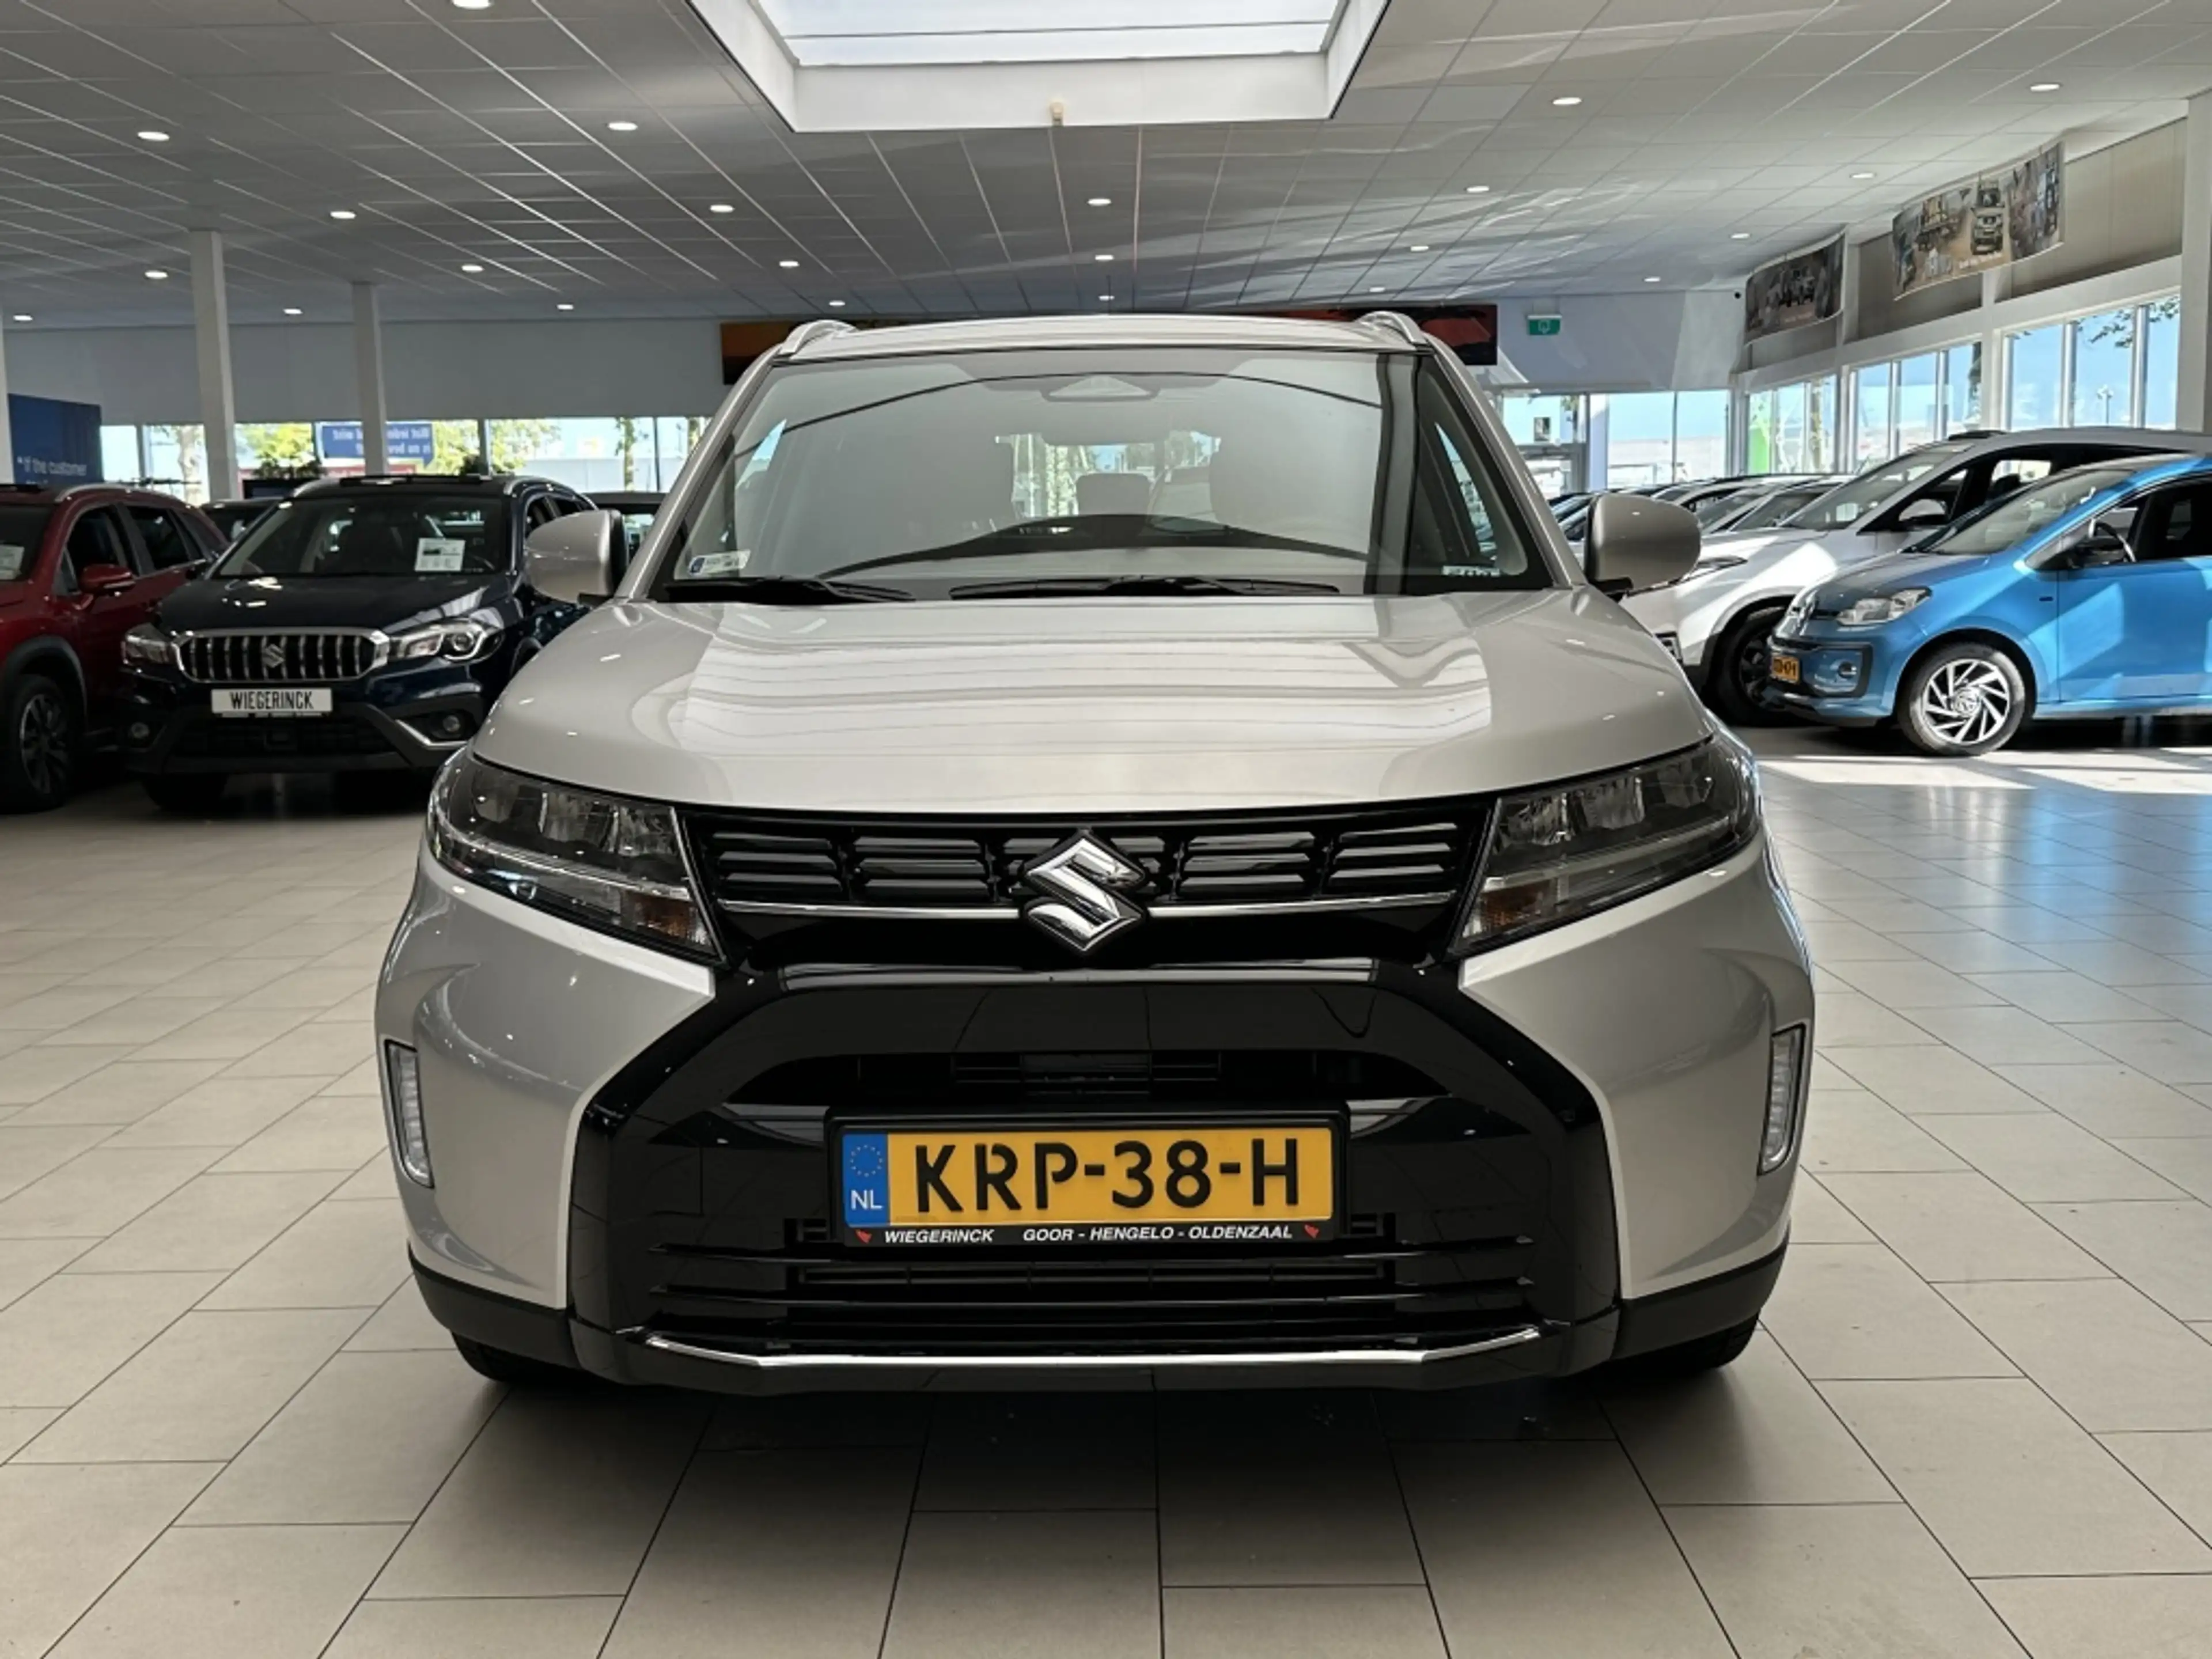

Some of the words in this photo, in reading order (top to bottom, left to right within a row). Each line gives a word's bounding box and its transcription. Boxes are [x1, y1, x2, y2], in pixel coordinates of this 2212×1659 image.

[229, 691, 314, 710] WIEGERINCK
[915, 1138, 1298, 1214] KRP-38-H
[851, 1189, 884, 1210] NL
[884, 1229, 995, 1244] WIEGERINCK
[1023, 1228, 1074, 1242] GOOR
[1090, 1226, 1174, 1241] HENGELO
[1188, 1225, 1293, 1240] OLDENZAAL
